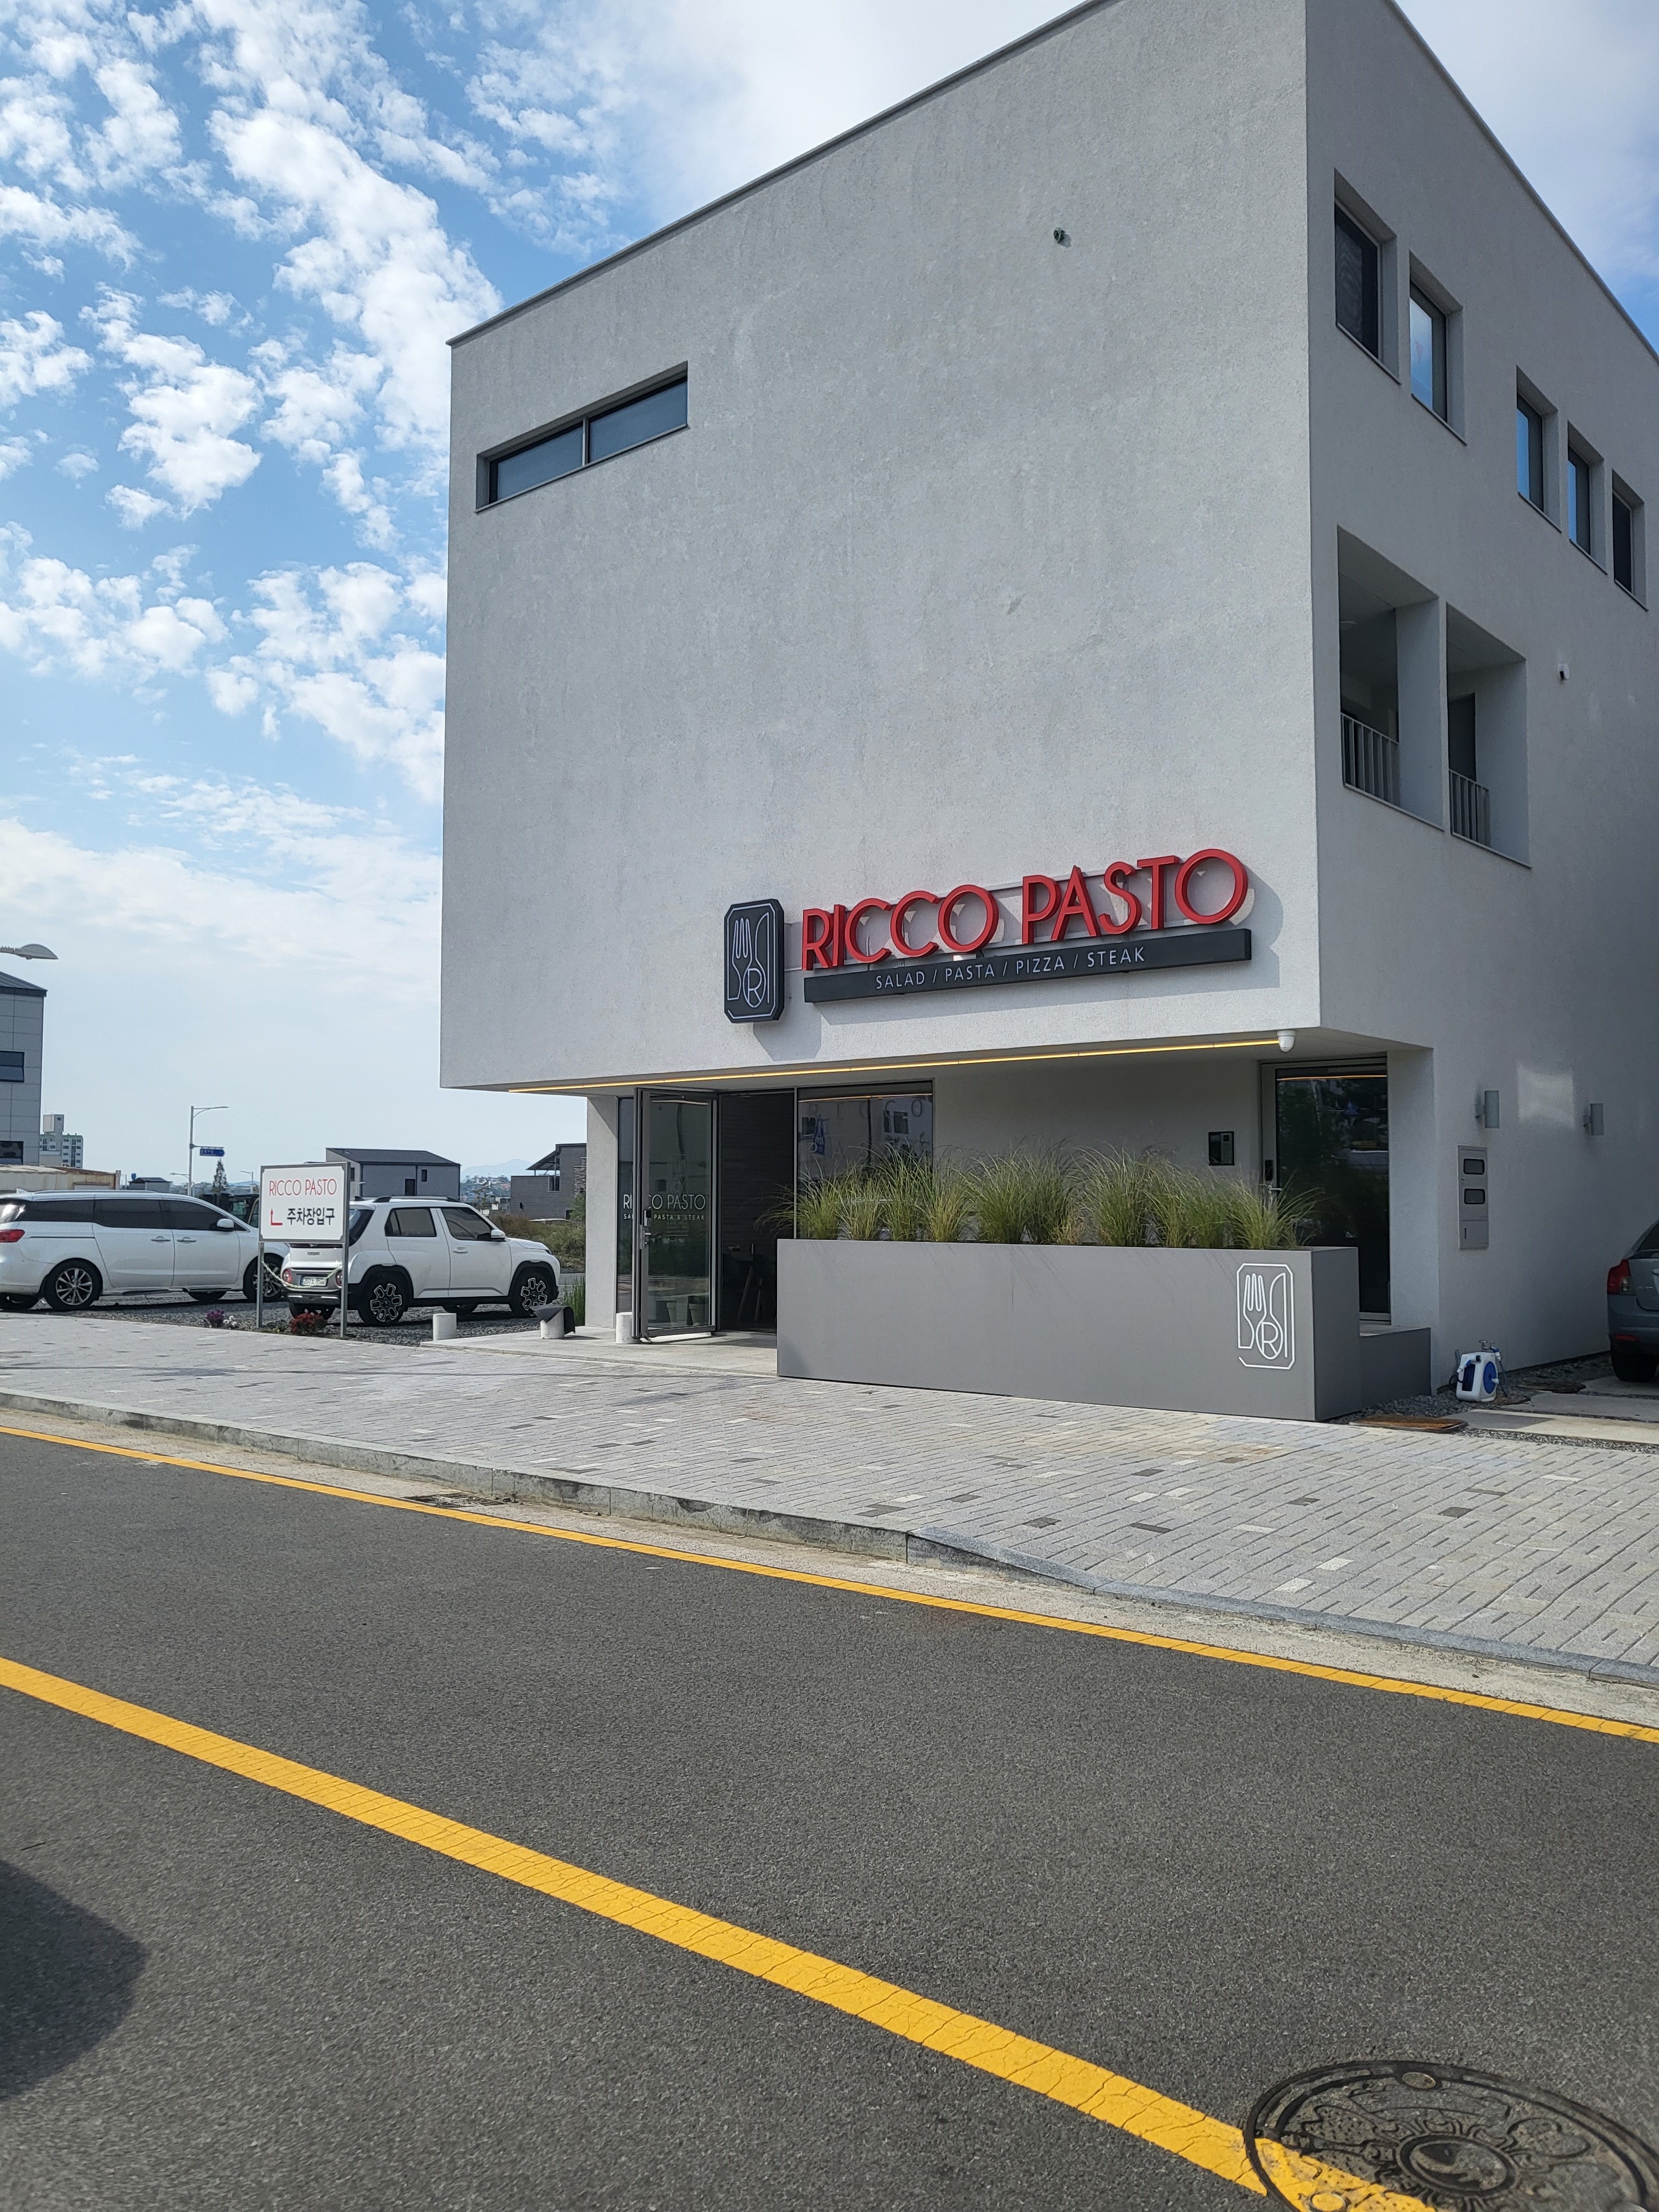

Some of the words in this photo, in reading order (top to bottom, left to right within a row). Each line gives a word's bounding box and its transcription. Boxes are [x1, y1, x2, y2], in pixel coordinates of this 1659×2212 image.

[801, 884, 999, 971] RICCO
[1021, 848, 1248, 945] PASTO
[875, 971, 925, 990] SALAD
[945, 963, 996, 983] PASTA
[1015, 956, 1066, 975] PIZZA
[1087, 946, 1146, 968] STEAK
[269, 1179, 302, 1196] RICCO
[305, 1178, 337, 1196] PASTO
[667, 1194, 706, 1210] PASTO
[286, 1207, 336, 1226] 주차장입구
